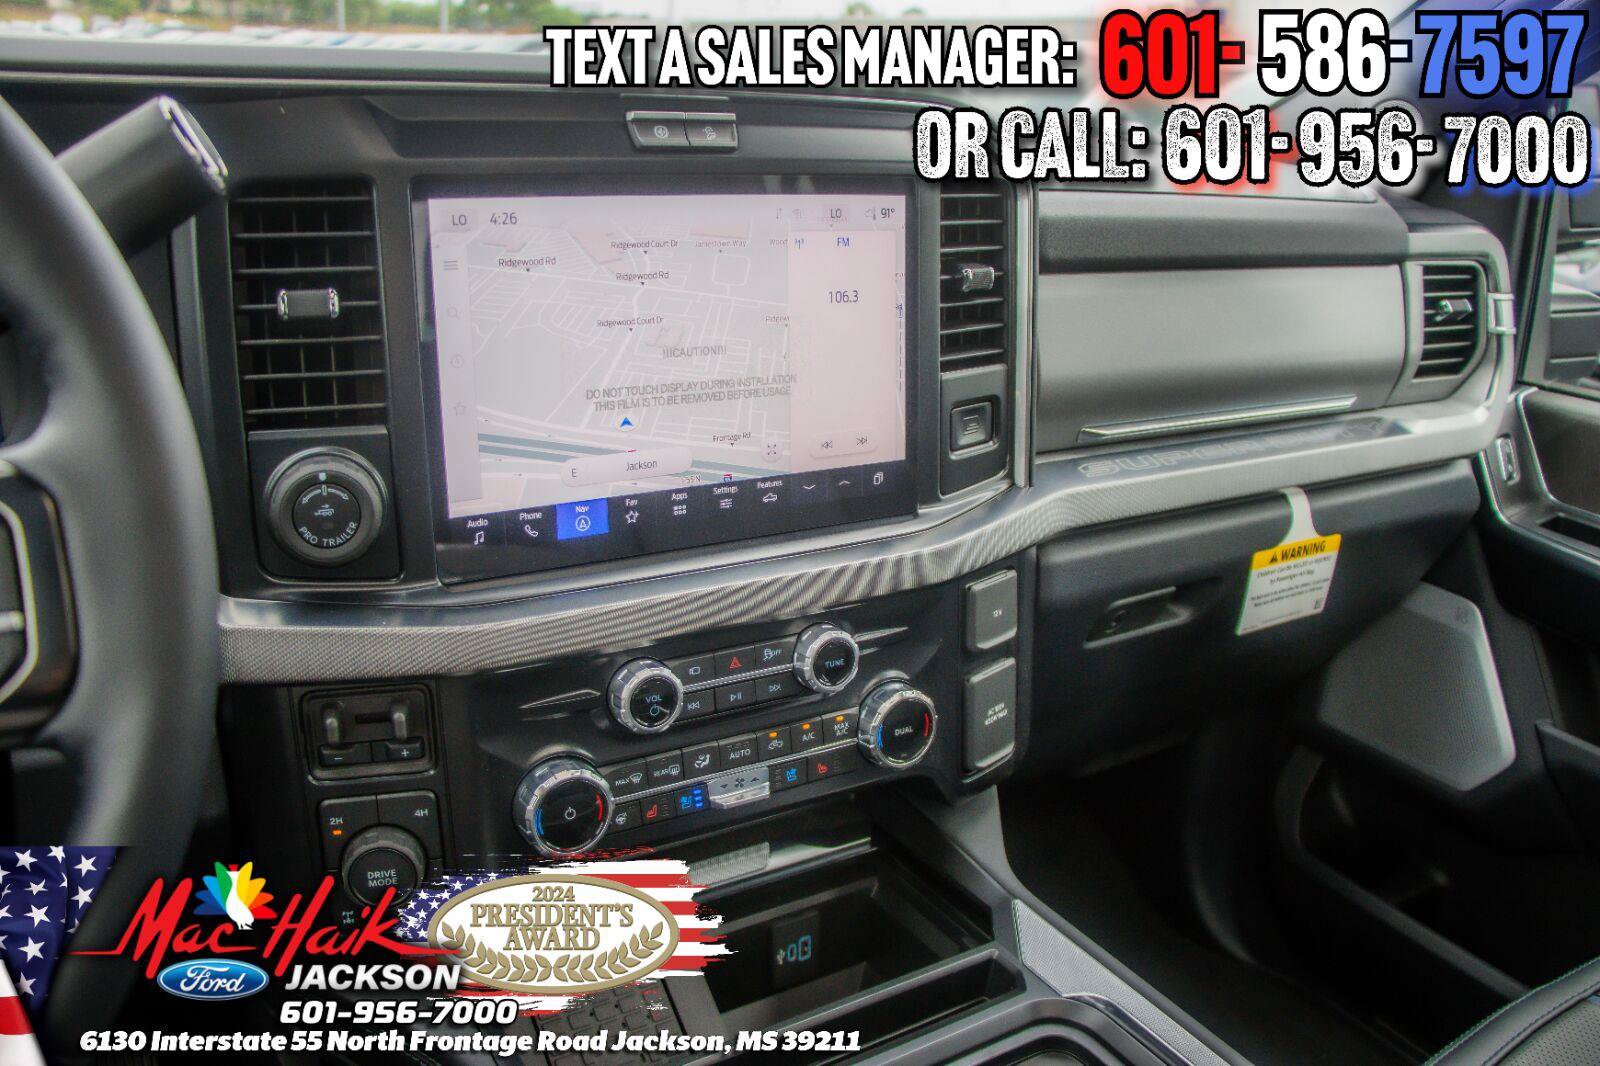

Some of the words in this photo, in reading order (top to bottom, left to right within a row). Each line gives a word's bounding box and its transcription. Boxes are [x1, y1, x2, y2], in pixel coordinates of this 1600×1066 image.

[489, 211, 518, 225] 4:26
[830, 208, 842, 219] LO
[452, 214, 467, 226] LO
[610, 241, 649, 250] Ridgewood
[651, 240, 669, 248] Court
[836, 237, 850, 247] FM
[498, 258, 543, 269] Ridgewood
[544, 256, 556, 265] Rd
[616, 272, 657, 281] Ridgewood
[658, 271, 670, 279] Rd
[828, 290, 859, 304] 106.3
[597, 319, 635, 328] Ridgewood
[636, 316, 654, 326] Court
[586, 389, 601, 400] DO
[603, 386, 623, 398] NOT
[625, 384, 659, 397] TOUCH
[661, 381, 699, 394] DISPLAY
[701, 378, 735, 391] DURING
[737, 373, 796, 388] INSTALLATION
[593, 400, 616, 413] THIS
[617, 399, 640, 411] FILM
[642, 398, 651, 409] IS
[652, 396, 666, 408] TO
[667, 395, 680, 407] BE
[681, 391, 726, 405] REMOVED
[727, 389, 762, 401] BEFORE
[763, 385, 792, 399] USAGE
[626, 459, 658, 472] Jackson
[571, 467, 577, 478] E
[757, 479, 783, 489] Features
[713, 486, 738, 496] Settings
[625, 498, 638, 507] Fav
[671, 492, 688, 502] Apps
[575, 504, 590, 514] Nav
[519, 510, 543, 522] Phone
[467, 518, 489, 529] Audio
[299, 526, 318, 545] PRO
[322, 521, 358, 547] TRAILER
[1281, 540, 1326, 562] WARNING
[825, 658, 845, 668] TUNE
[645, 694, 662, 703] VOL
[834, 722, 850, 731] MAX
[894, 726, 914, 737] DUAL
[802, 732, 816, 742] A/C
[729, 749, 751, 760] AUTO
[615, 777, 630, 787] MAX
[414, 808, 429, 818] 4H
[330, 817, 344, 826] 2H
[367, 869, 397, 881] DRIVE
[368, 877, 399, 888] MODE
